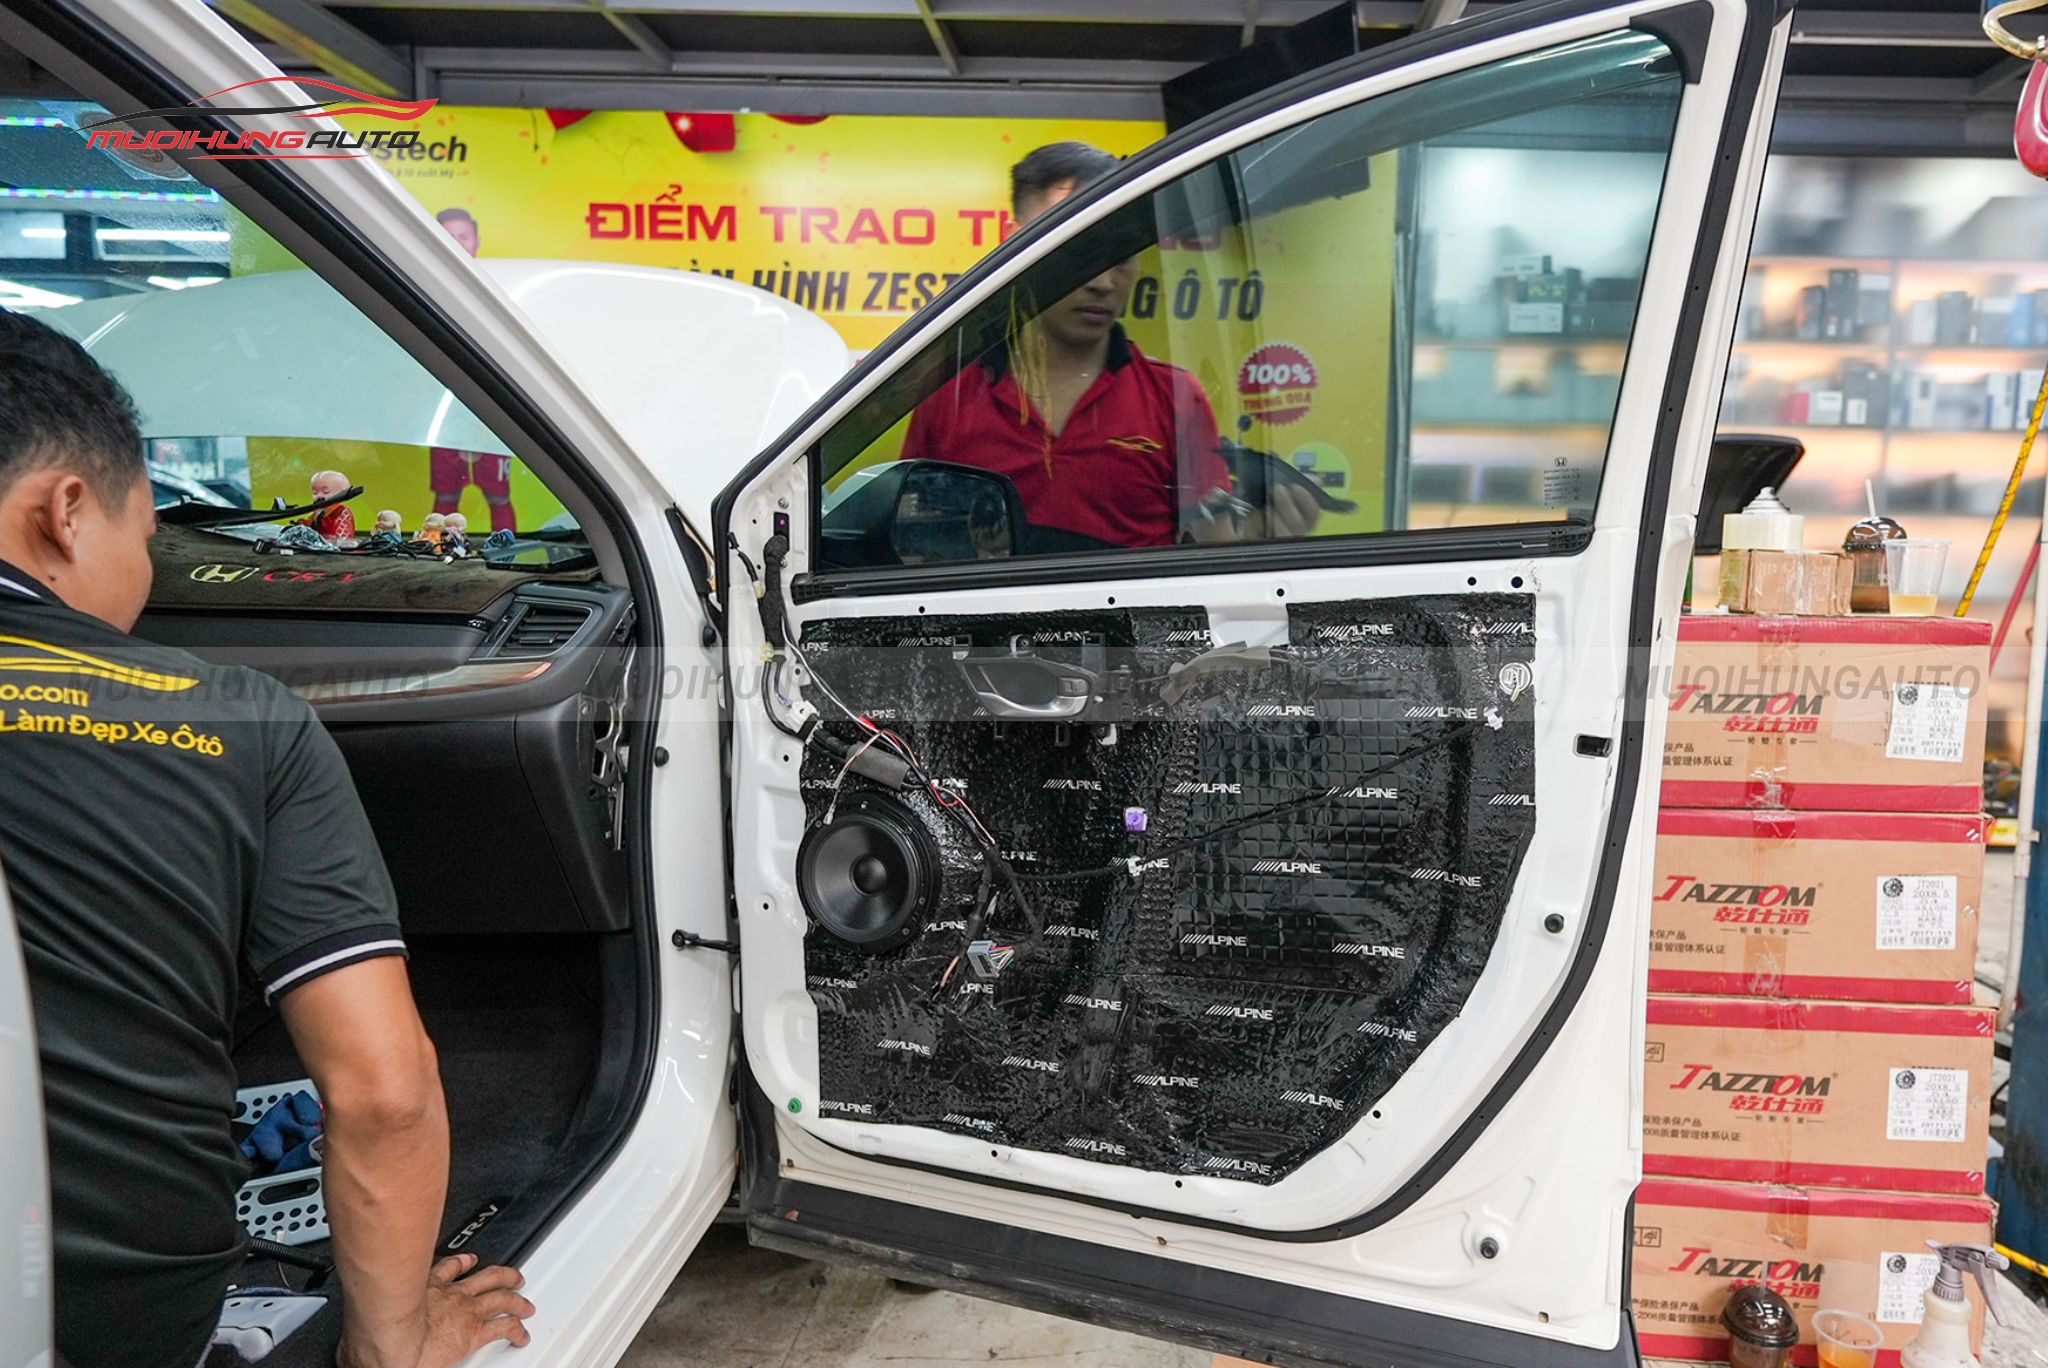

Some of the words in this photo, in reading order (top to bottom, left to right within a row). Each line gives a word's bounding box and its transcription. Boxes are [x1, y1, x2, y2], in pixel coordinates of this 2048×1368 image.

[586, 184, 736, 242] ĐIỂM
[760, 205, 936, 246] TRAO
[1172, 268, 1201, 321] Ô
[1217, 269, 1265, 322] TÔ
[1247, 363, 1313, 386] 100%
[1347, 624, 1393, 635] ALPINE
[0, 684, 89, 708] o.com
[1273, 705, 1315, 716] ALPINE
[1431, 707, 1477, 718] ALPINE
[0, 708, 65, 733] Làm
[68, 714, 129, 743] Đẹp
[130, 721, 168, 746] Xe
[1063, 780, 1101, 790] ALPINE
[1197, 783, 1241, 794] ALPINE
[1350, 787, 1397, 798] ALPINE
[1275, 862, 1322, 873] ALPINE
[1438, 873, 1481, 886] ALPINE
[1203, 935, 1246, 946] ALPINE
[1357, 945, 1404, 958] ALPINE
[1084, 999, 1123, 1011] ALPINE
[1229, 1008, 1272, 1020] ALPINE
[898, 1042, 930, 1055] ALPINE
[1020, 1059, 1059, 1072] ALPINE
[1155, 1076, 1198, 1087] ALPINE
[836, 1103, 872, 1114] ALPINE
[1088, 1141, 1125, 1155] ALPINE
[1229, 1160, 1271, 1175] ALPINE
[448, 1204, 498, 1249] CR-V
